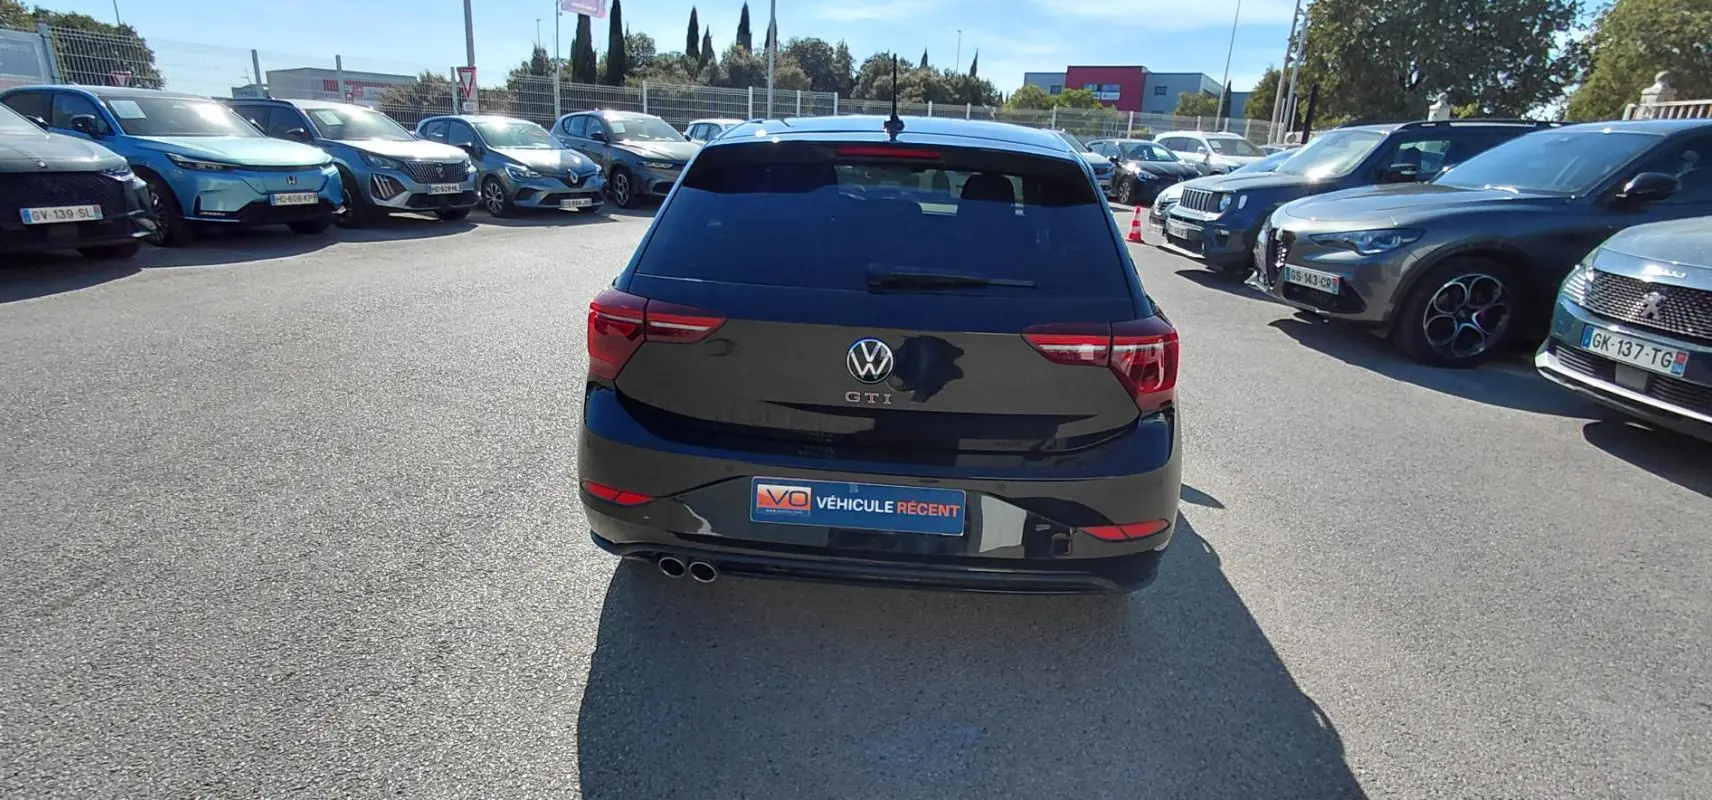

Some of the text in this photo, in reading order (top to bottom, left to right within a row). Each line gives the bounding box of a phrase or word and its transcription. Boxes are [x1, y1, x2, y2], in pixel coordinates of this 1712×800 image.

[1592, 333, 1673, 368] GK-137-TG
[844, 391, 892, 405] GTI
[816, 495, 894, 514] VÉHICULE
[897, 500, 960, 518] RÉCENT
